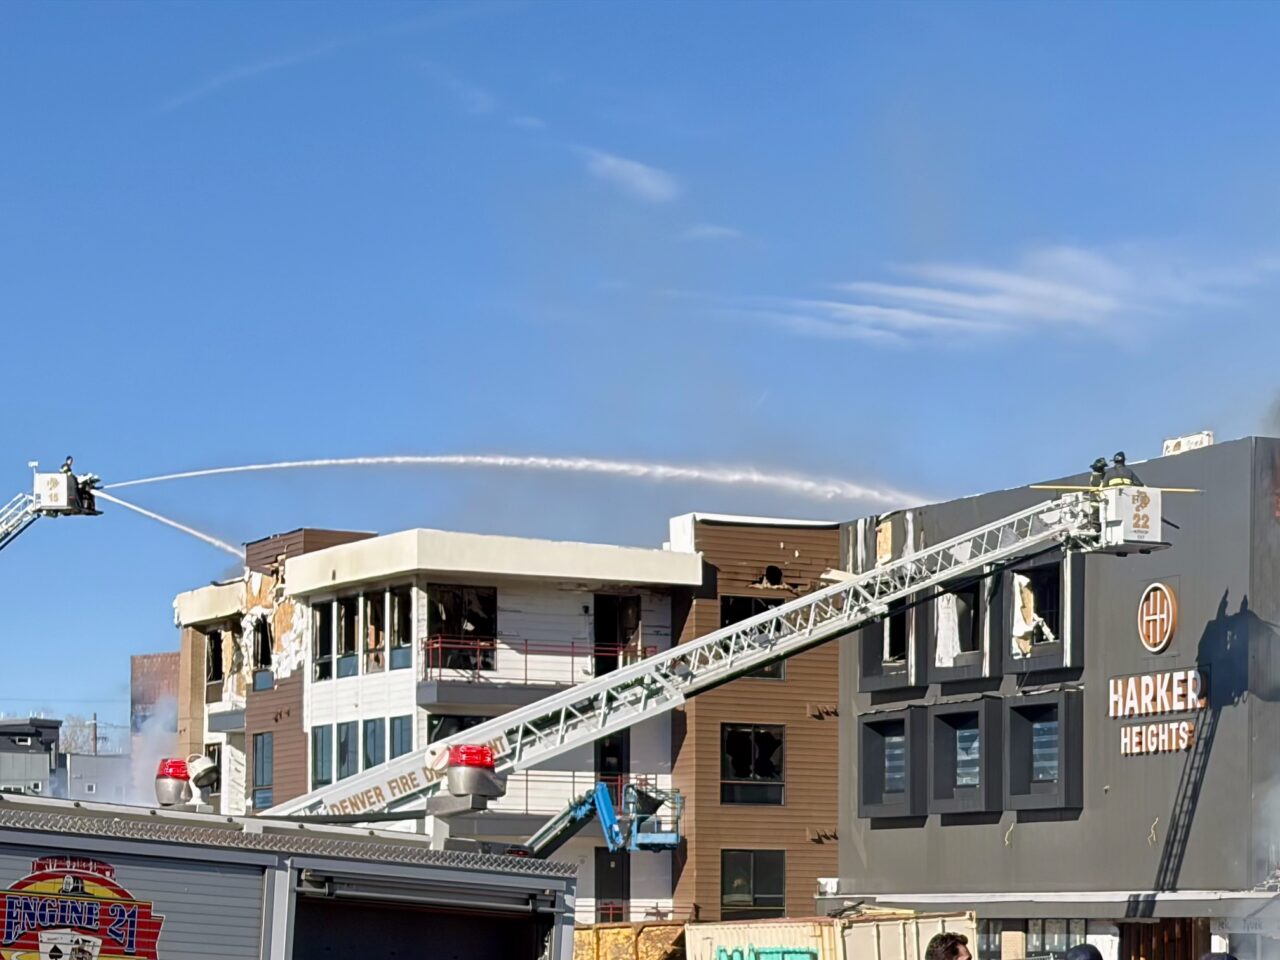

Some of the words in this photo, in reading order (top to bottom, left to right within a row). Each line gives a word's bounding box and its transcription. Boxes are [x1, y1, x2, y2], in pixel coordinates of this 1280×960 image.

[1132, 512, 1150, 529] 22
[1109, 669, 1205, 718] HARKER
[1121, 720, 1191, 755] HEIGHTS
[329, 784, 386, 815] DENVER
[387, 771, 421, 797] FIRE
[3, 895, 100, 944] ENGINE
[107, 904, 138, 953] 21
